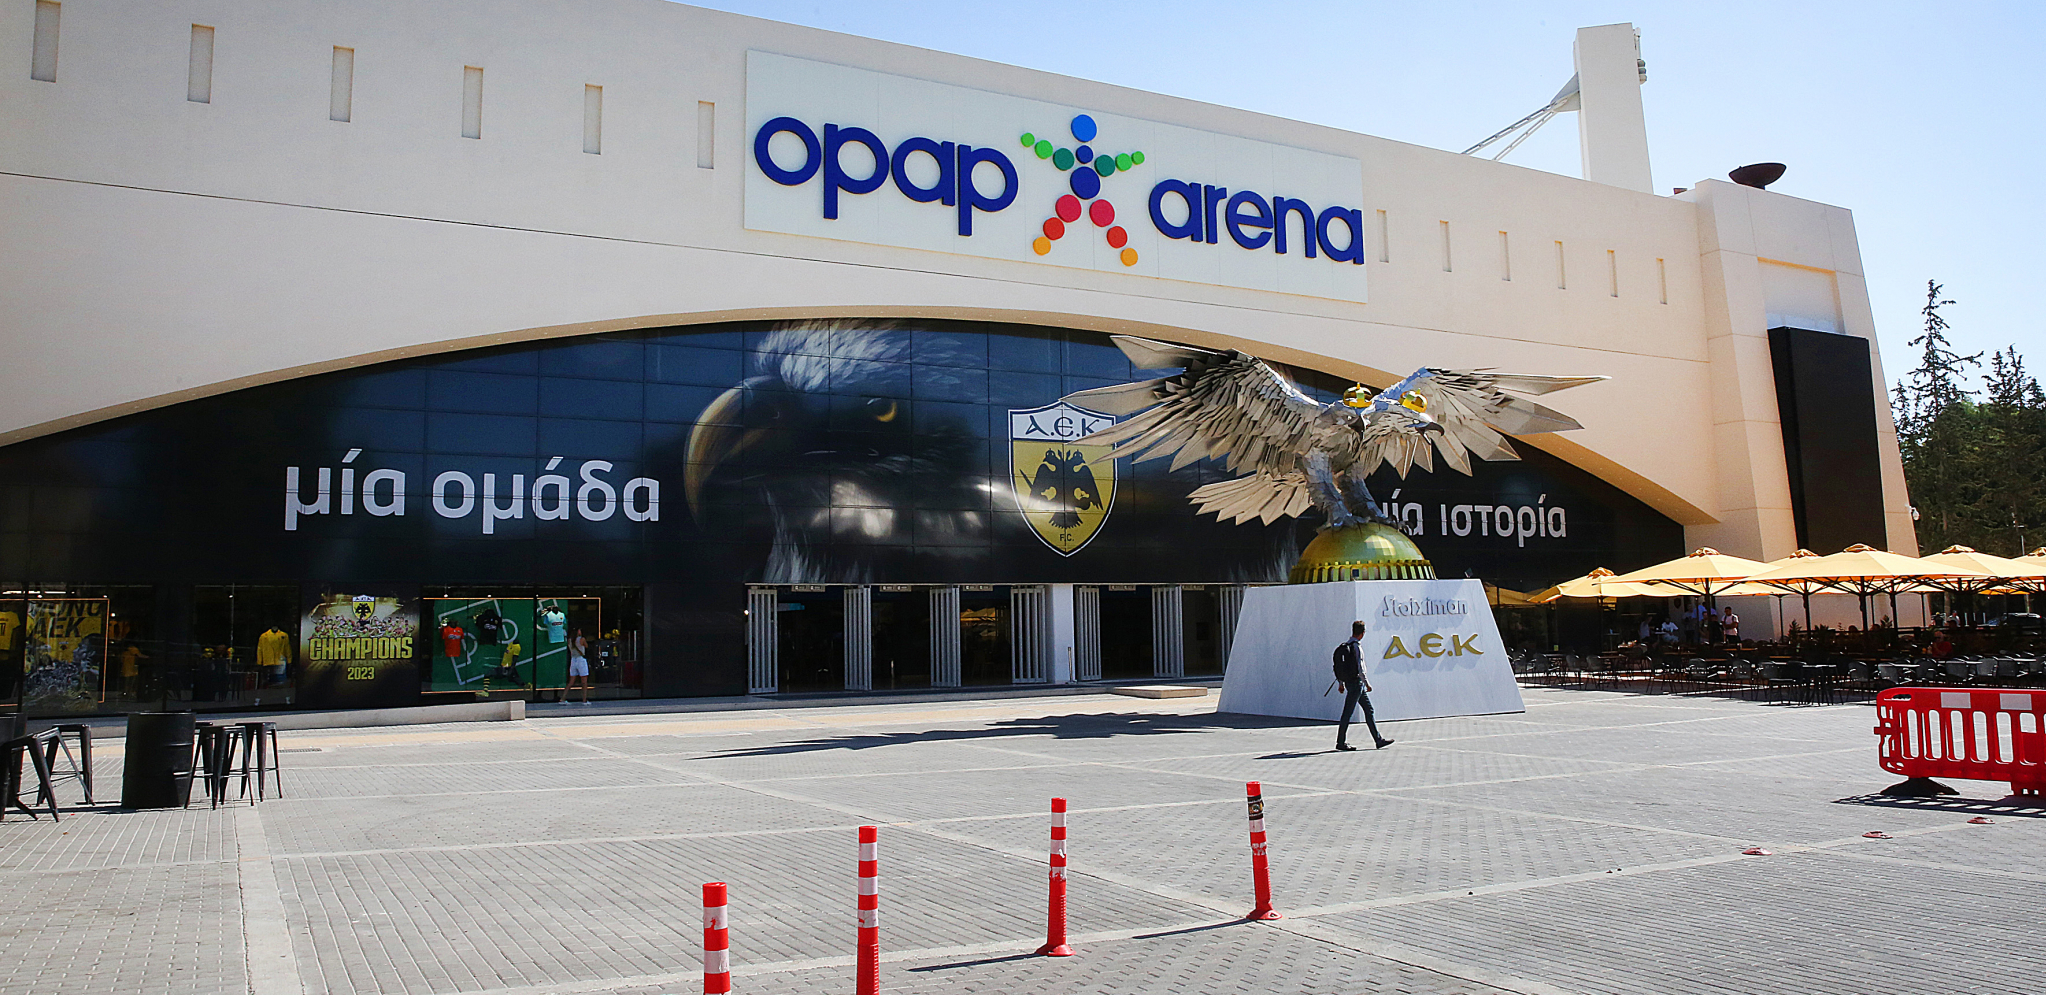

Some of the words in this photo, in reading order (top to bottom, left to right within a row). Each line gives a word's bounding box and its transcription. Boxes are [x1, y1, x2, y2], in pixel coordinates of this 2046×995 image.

[754, 116, 1018, 237] opap
[1148, 178, 1365, 265] arena
[285, 448, 405, 531] μία
[432, 456, 660, 535] ομάδα
[1440, 493, 1567, 548] ιστορία
[309, 637, 413, 661] CHAMPIONS
[347, 666, 375, 681] 2023
